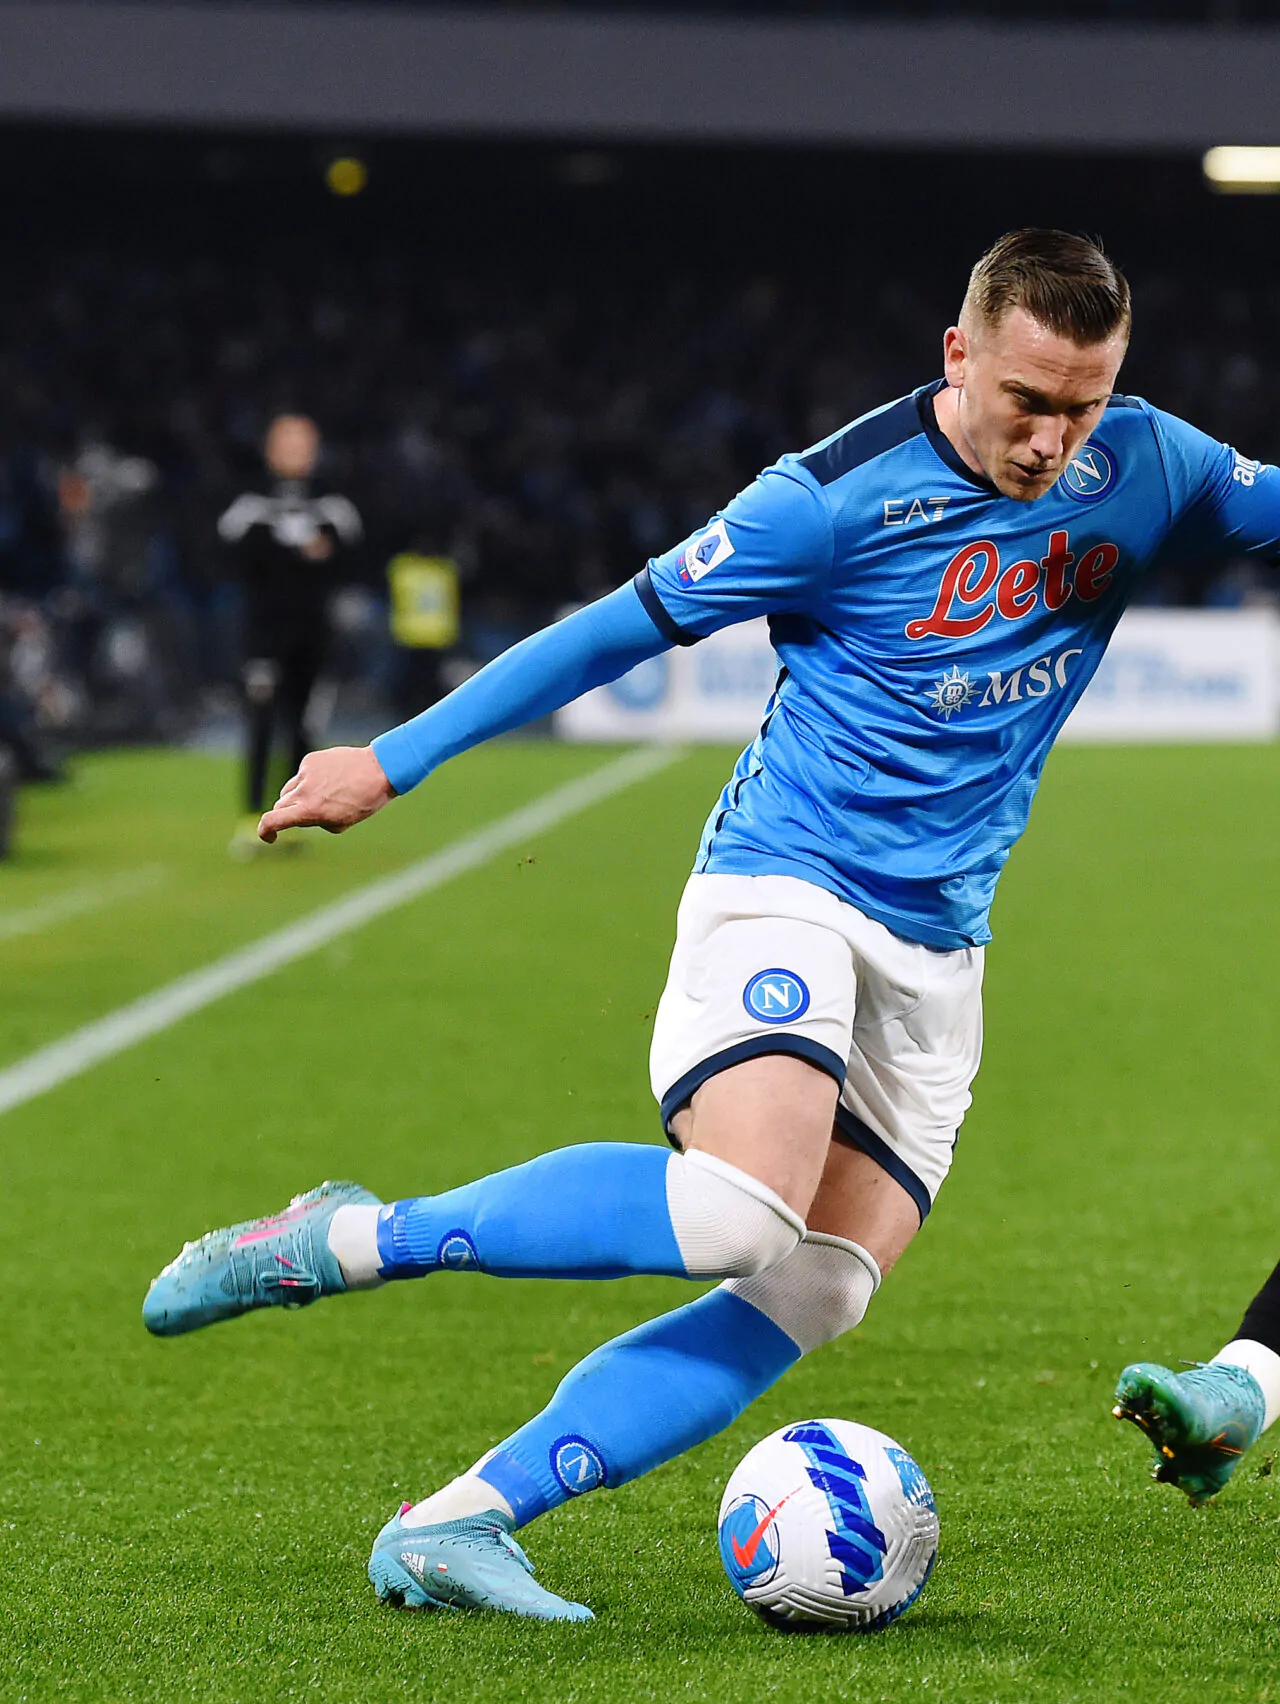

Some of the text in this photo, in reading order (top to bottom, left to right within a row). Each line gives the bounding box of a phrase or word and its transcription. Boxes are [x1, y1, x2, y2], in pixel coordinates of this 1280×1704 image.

[1069, 452, 1102, 488] N
[883, 496, 951, 525] EA7
[905, 529, 1120, 640] Lete
[977, 649, 1083, 708] MSC
[761, 982, 792, 1009] N
